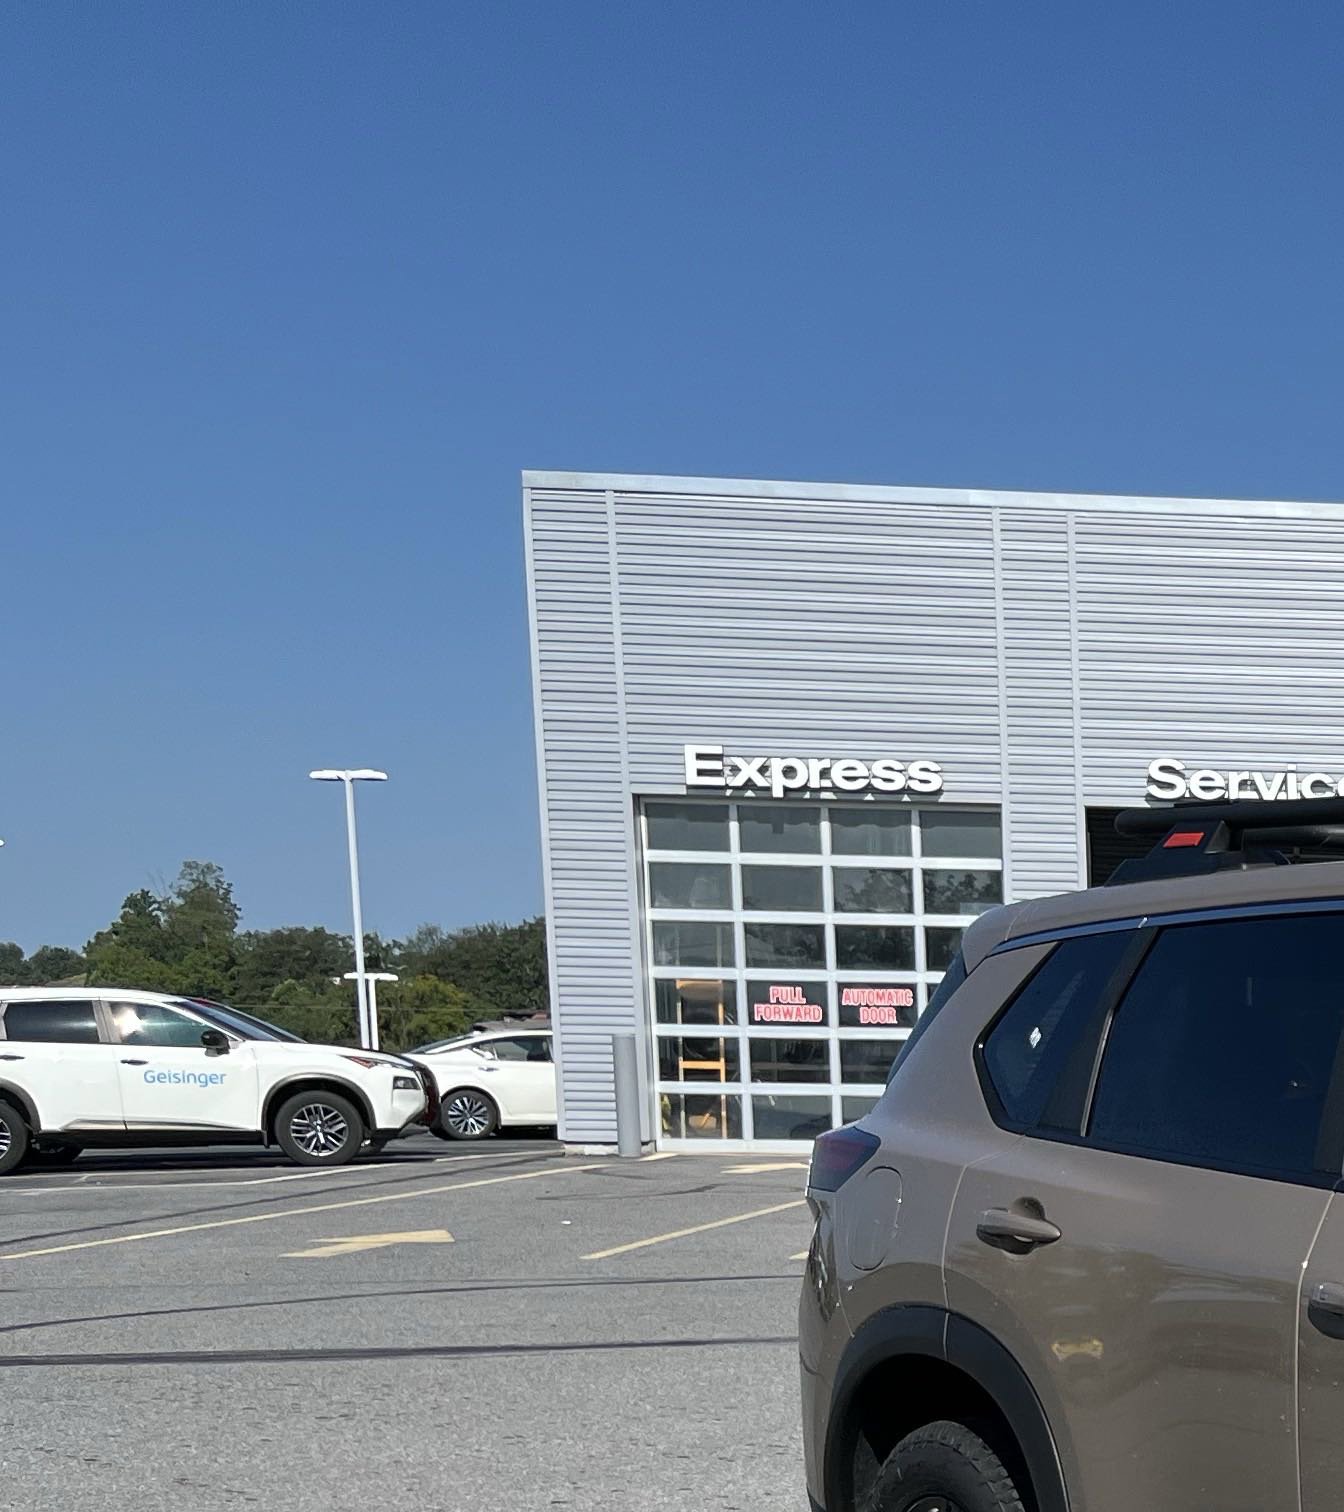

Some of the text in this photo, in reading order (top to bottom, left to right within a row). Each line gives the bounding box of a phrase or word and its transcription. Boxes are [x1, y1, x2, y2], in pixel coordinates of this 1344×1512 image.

[684, 744, 943, 798] Express
[770, 986, 806, 1004] PULL
[842, 988, 913, 1006] AUTOMATIC
[754, 1004, 822, 1022] FORWARD
[860, 1007, 898, 1024] DOOR
[143, 1070, 227, 1087] Geisinger
